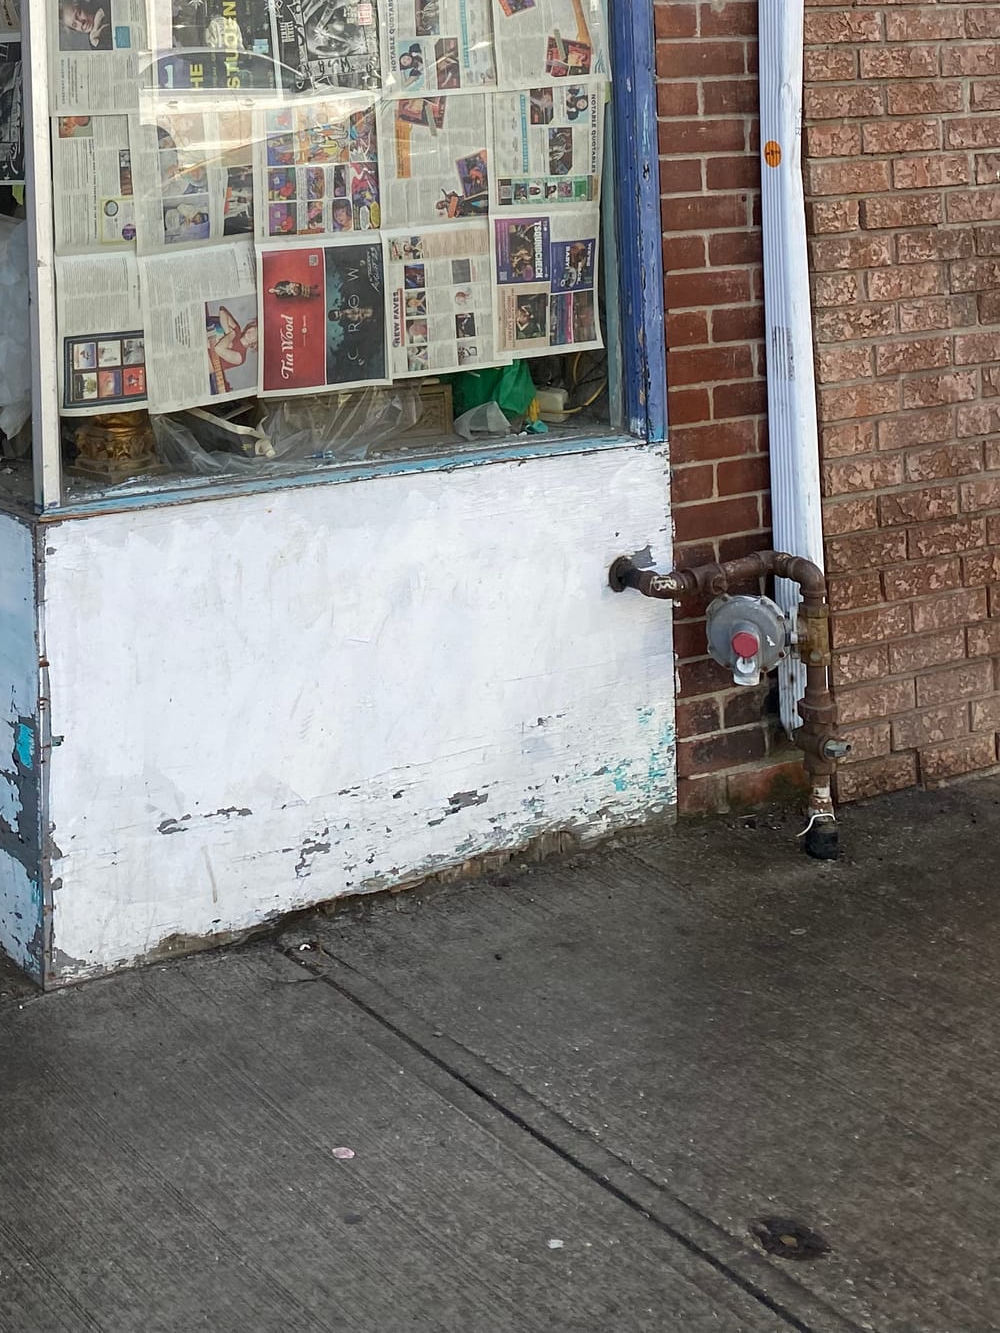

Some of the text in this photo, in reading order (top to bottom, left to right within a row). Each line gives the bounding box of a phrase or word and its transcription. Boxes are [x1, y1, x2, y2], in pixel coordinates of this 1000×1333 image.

[389, 37, 397, 72] NOTABLE
[345, 266, 361, 361] CROW
[392, 291, 400, 320] FAVES
[279, 313, 294, 379] Tia Wood
